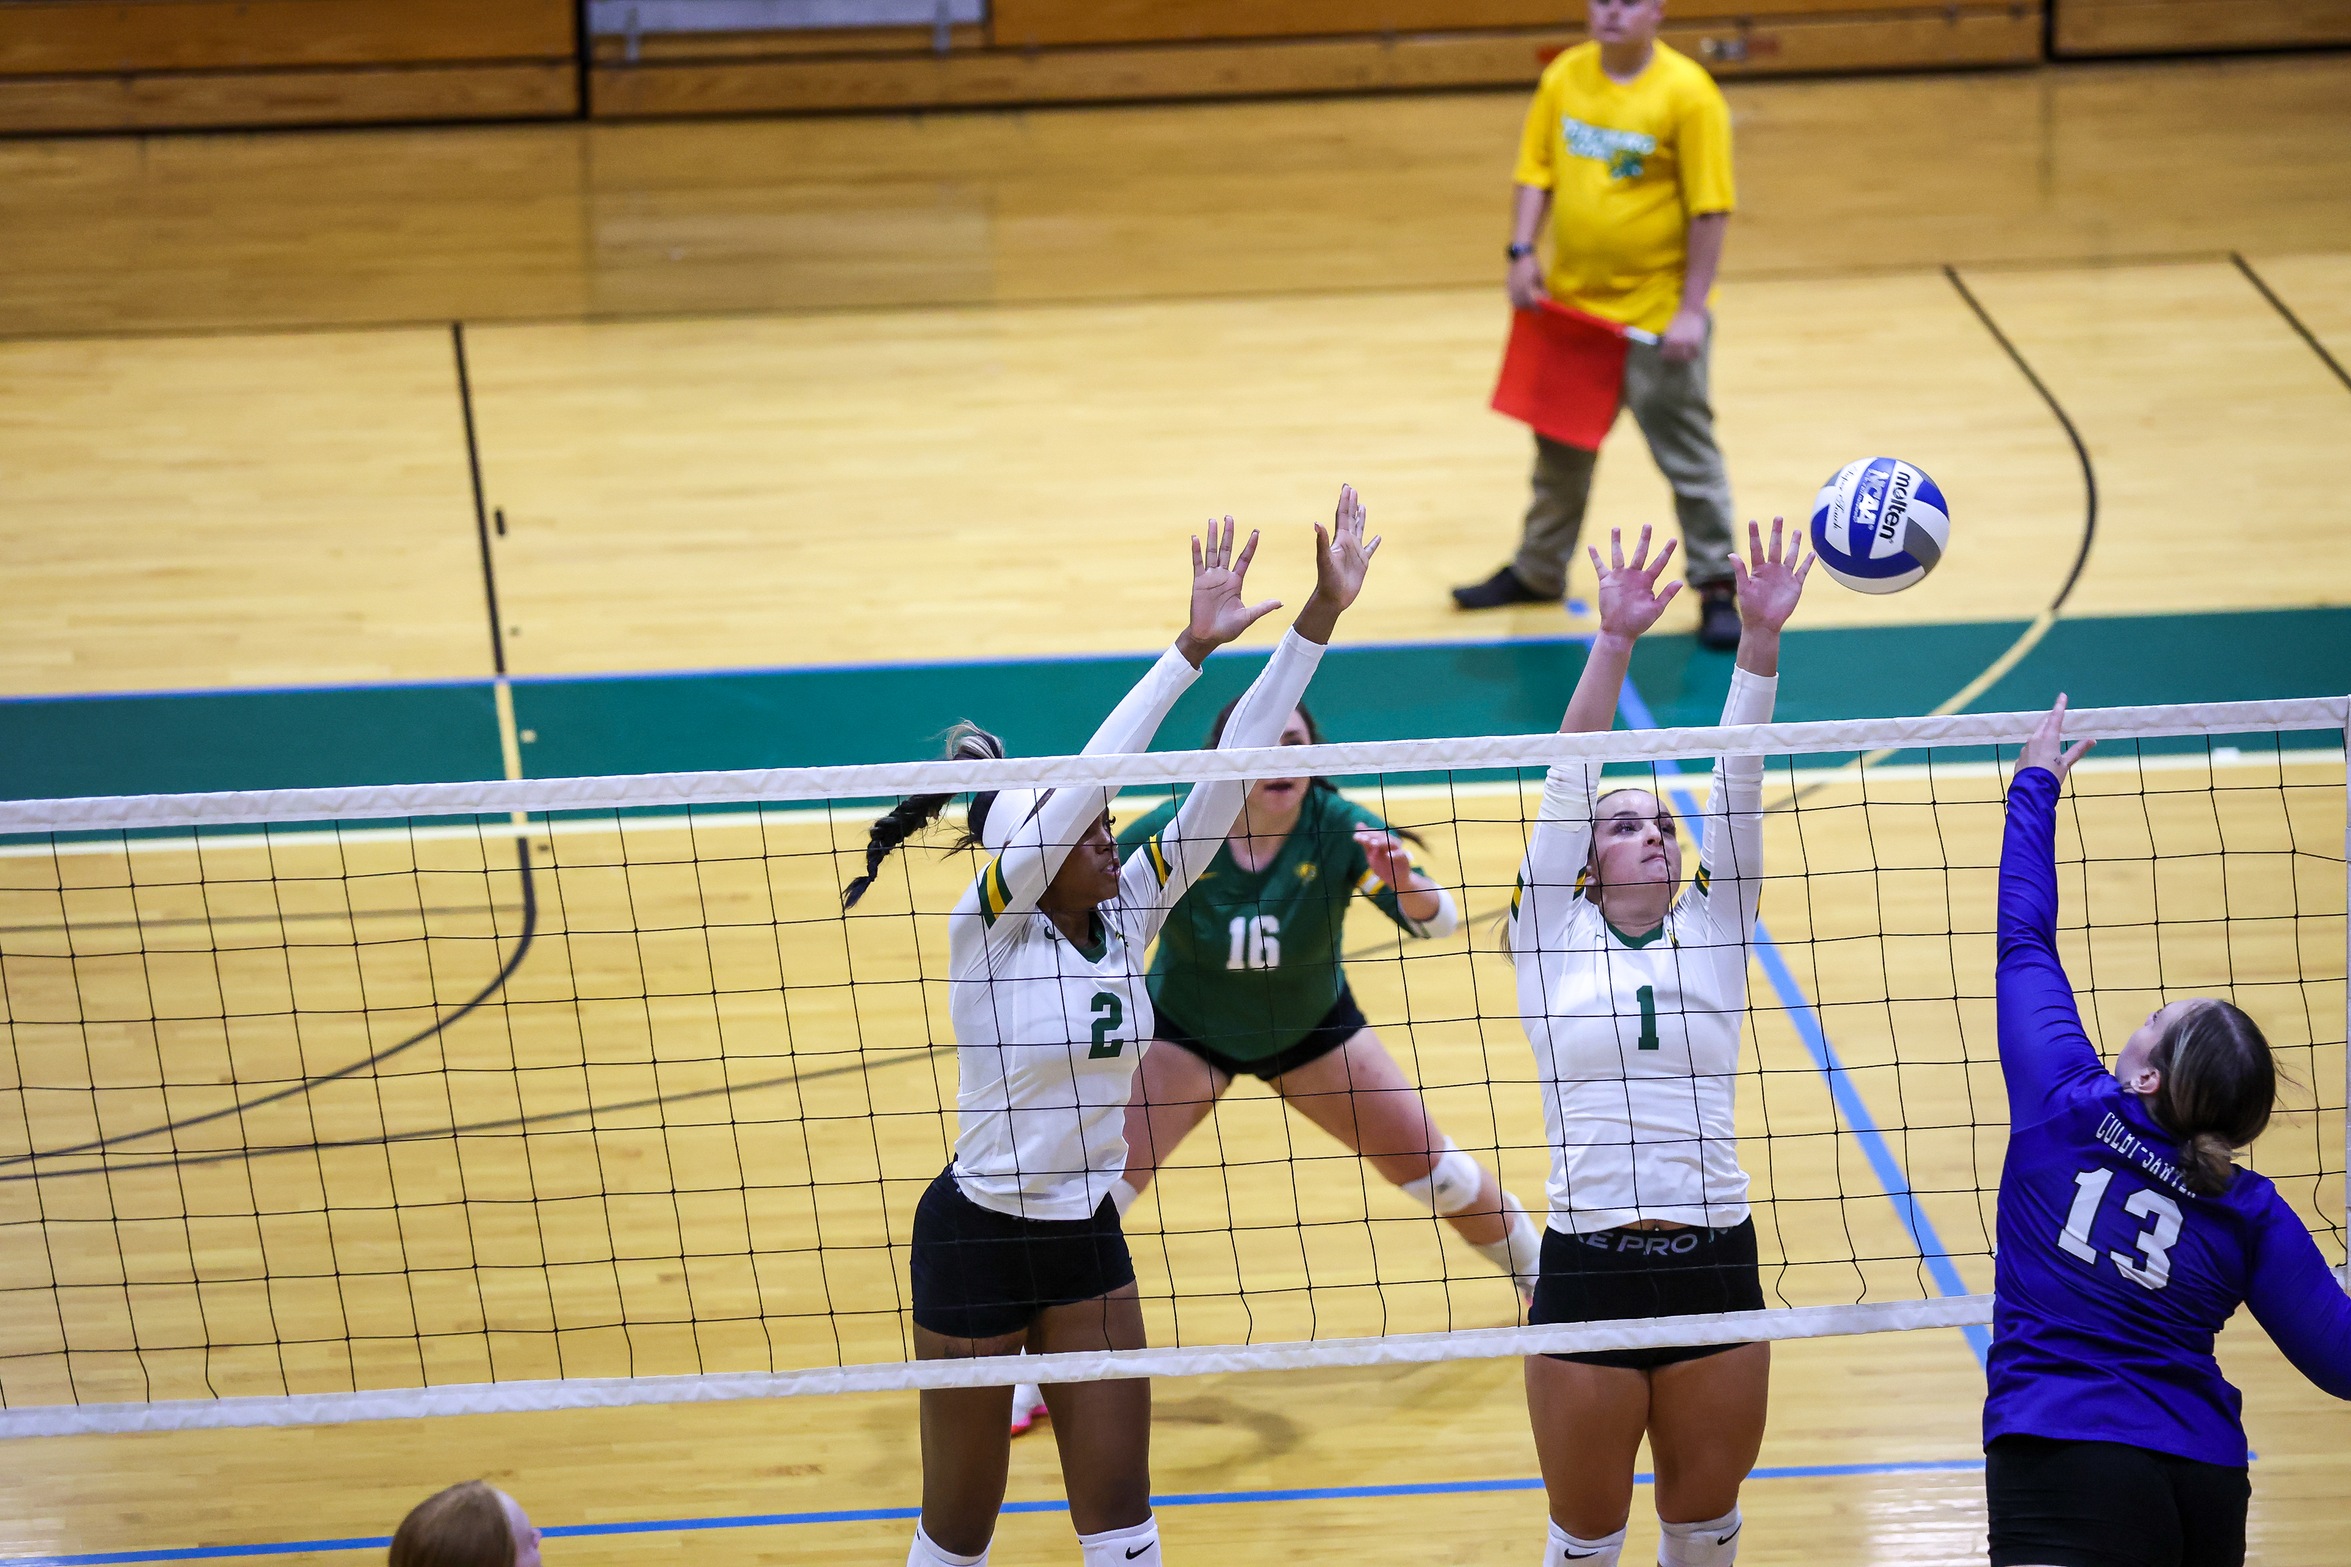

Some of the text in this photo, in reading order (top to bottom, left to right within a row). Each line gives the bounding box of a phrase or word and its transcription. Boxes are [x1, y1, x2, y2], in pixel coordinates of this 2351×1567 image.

[1854, 468, 1890, 525] NCAA
[1879, 471, 1911, 540] molten
[1226, 915, 1281, 971] 16
[1088, 991, 1124, 1059] 2
[1636, 985, 1660, 1051] 1
[1616, 1233, 1698, 1256] PRO
[2057, 1167, 2184, 1290] 13
